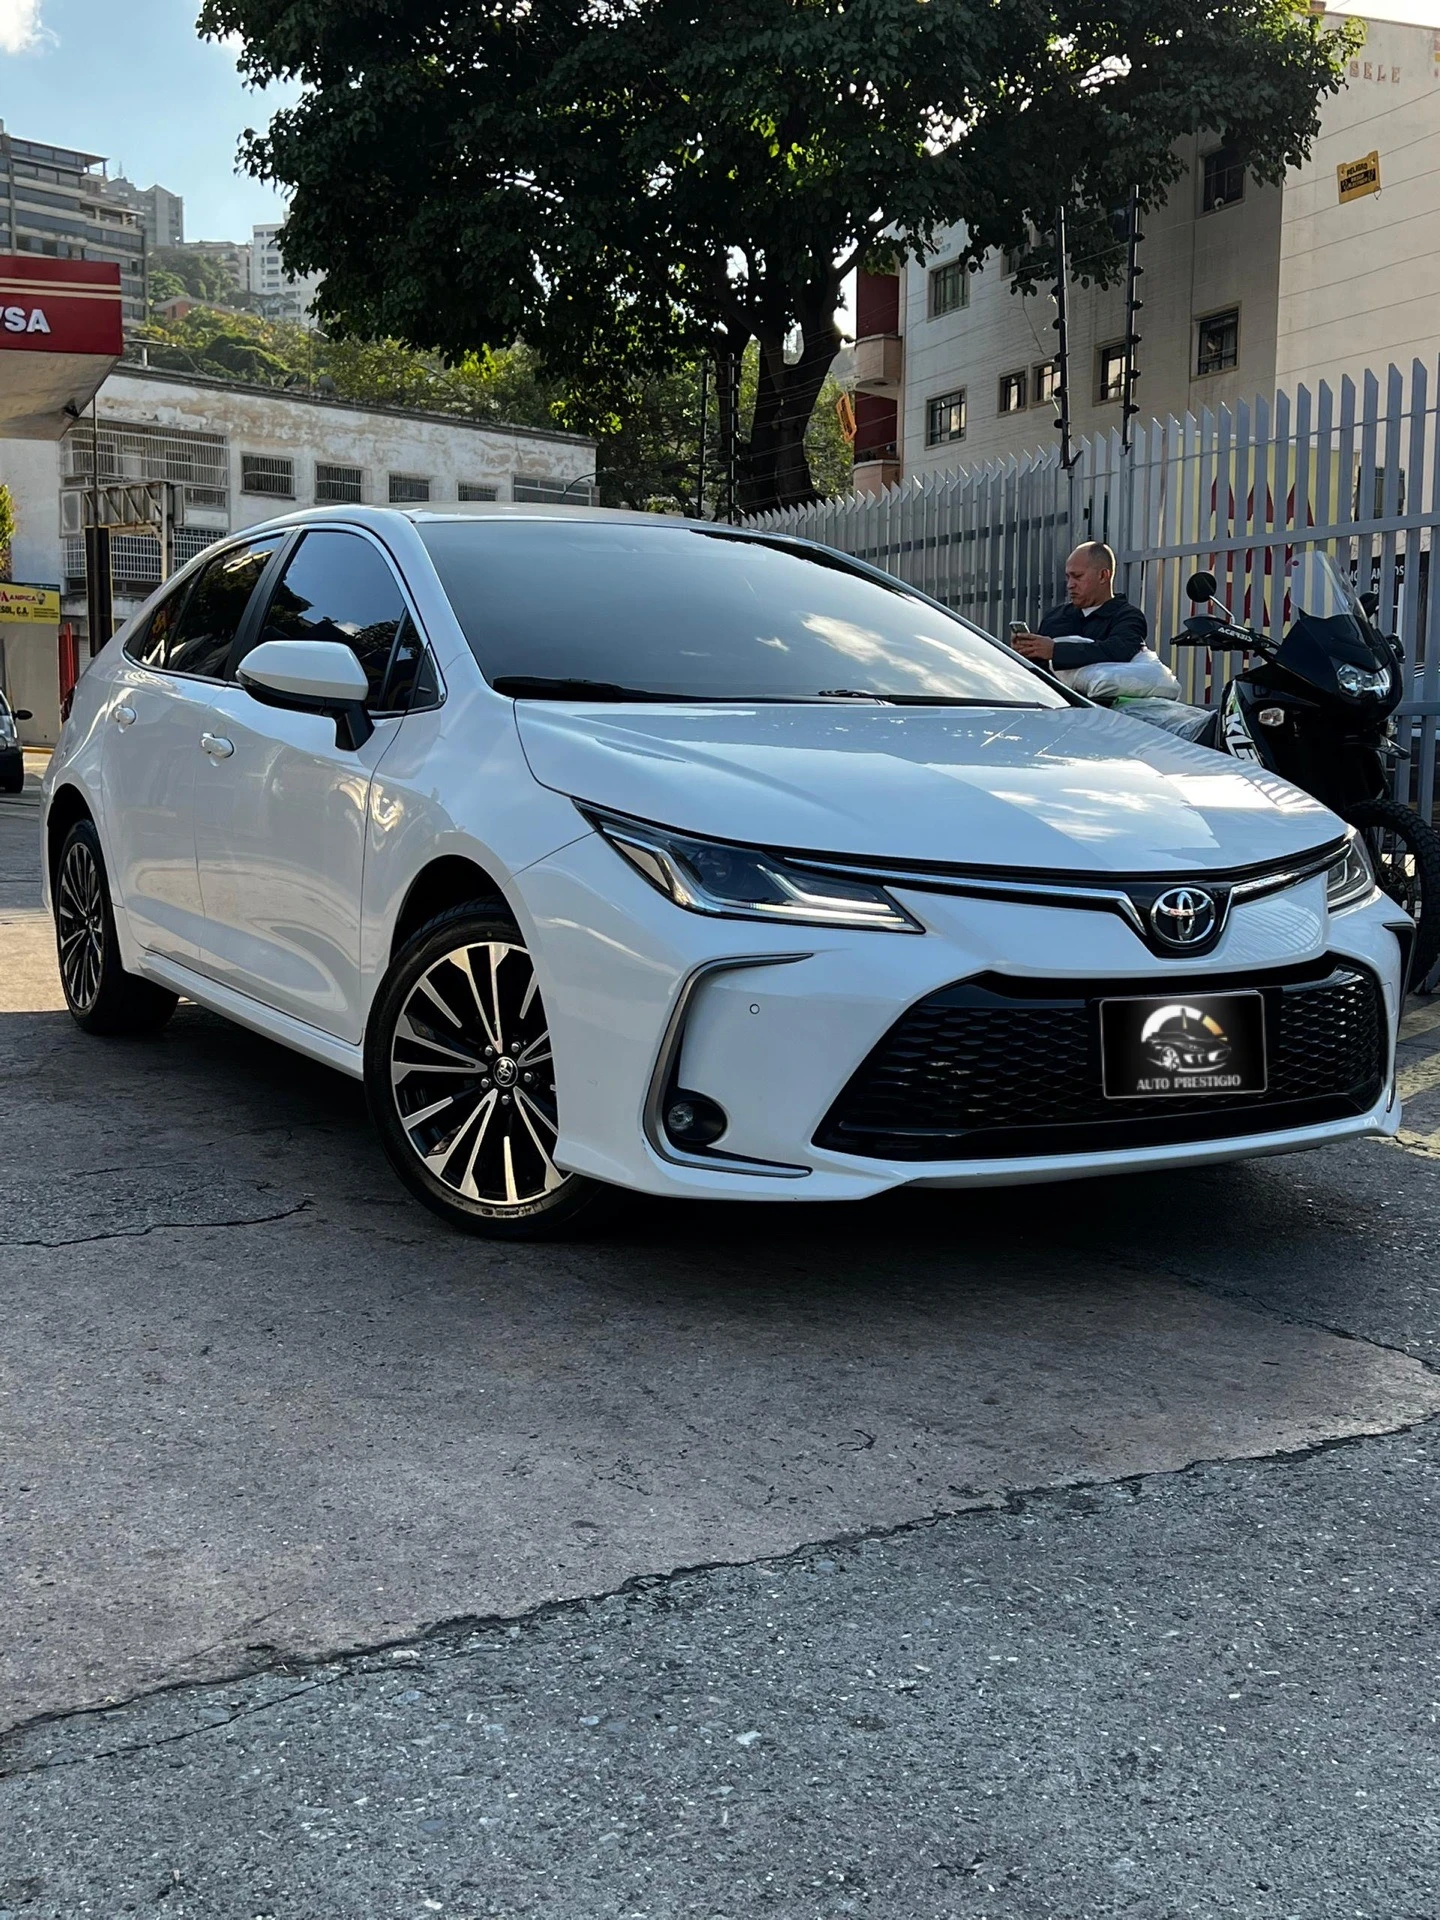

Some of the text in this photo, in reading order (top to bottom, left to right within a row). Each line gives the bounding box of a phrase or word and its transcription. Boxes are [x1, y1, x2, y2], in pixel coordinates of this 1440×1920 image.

[0, 306, 51, 333] SA
[1137, 1074, 1241, 1091] AUTO PRESTIGIO
